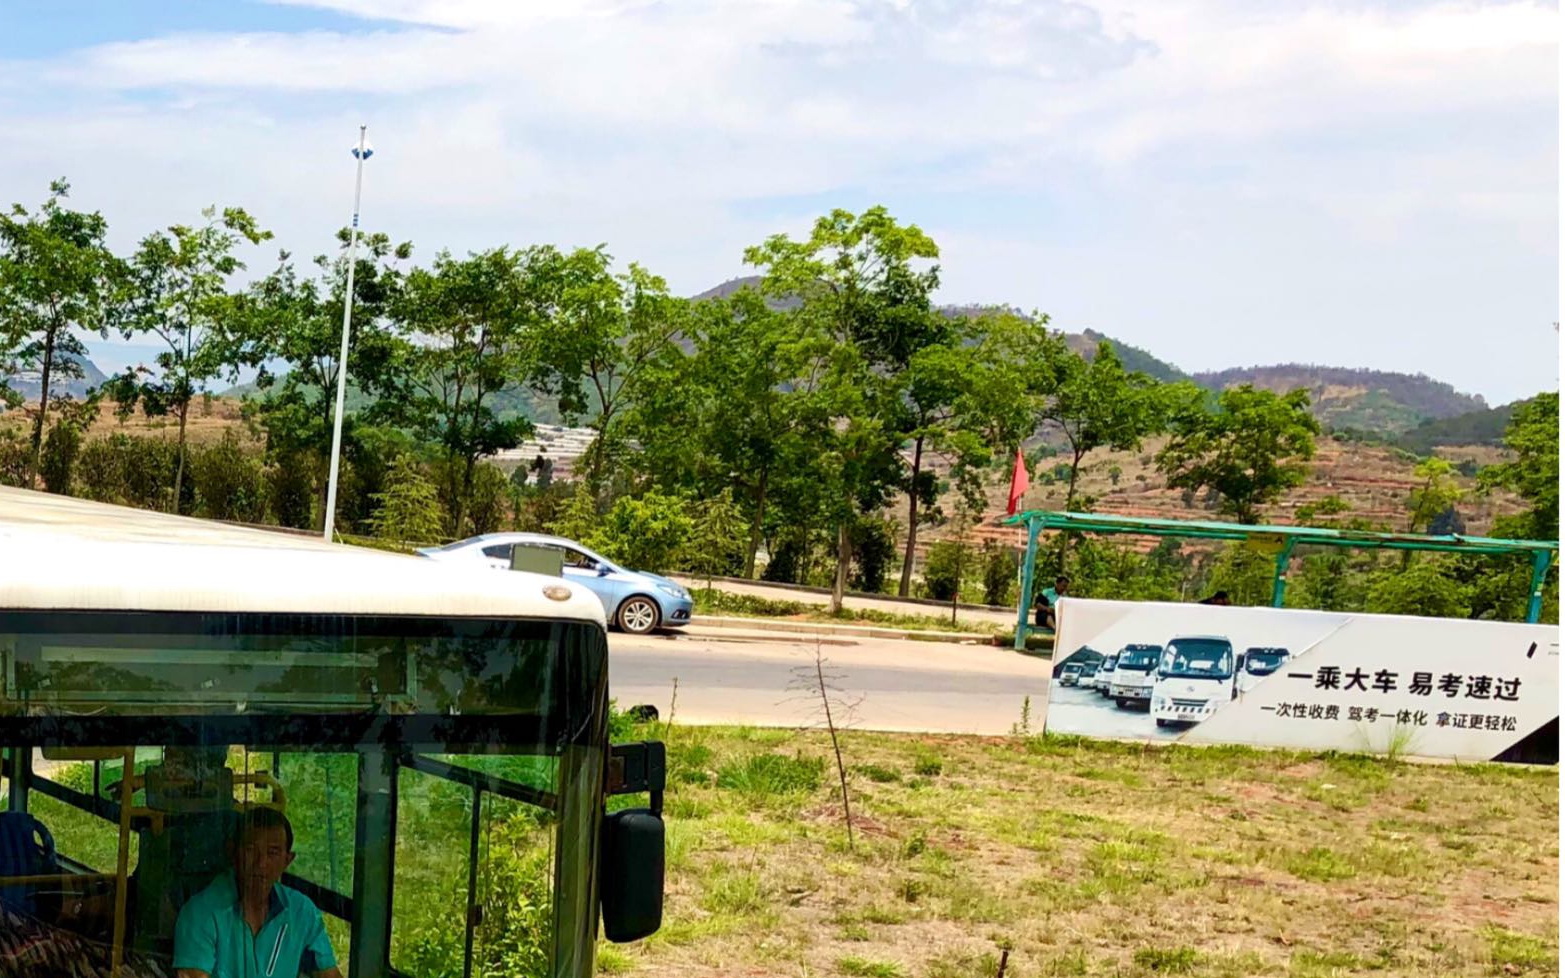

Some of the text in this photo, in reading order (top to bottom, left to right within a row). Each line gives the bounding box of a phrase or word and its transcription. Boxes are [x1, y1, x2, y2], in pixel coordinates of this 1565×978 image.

[1287, 665, 1523, 702] 一乘大车 易考速过
[1260, 702, 1518, 732] 一次性收费 驾考一体化 拿证更轻松
